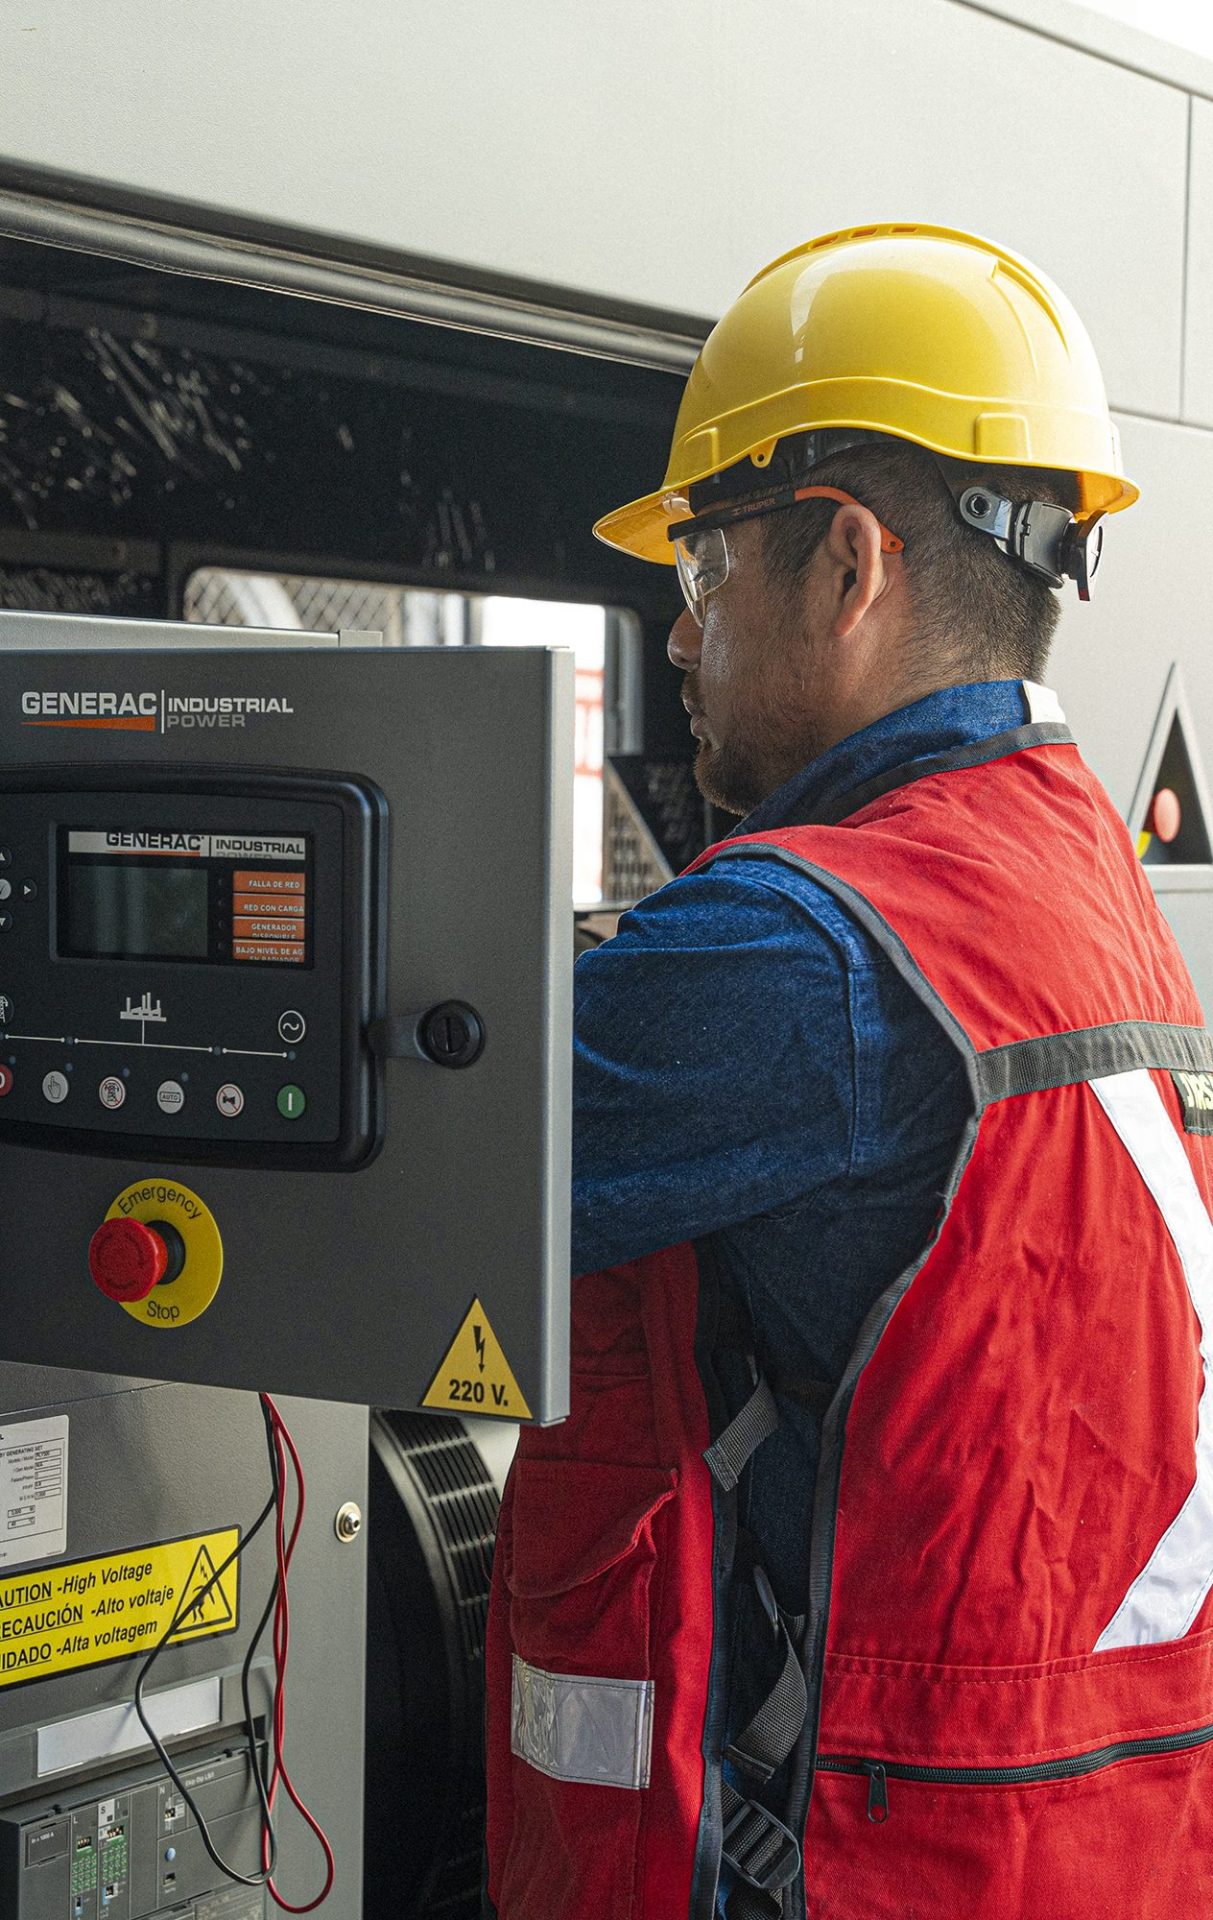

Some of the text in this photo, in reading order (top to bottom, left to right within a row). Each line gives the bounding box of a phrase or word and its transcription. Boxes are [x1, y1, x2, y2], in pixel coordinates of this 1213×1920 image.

[21, 691, 294, 715] GENERAC INDUSTRIAL
[167, 714, 246, 728] POWER
[106, 832, 304, 854] GENERAC INDUSTRIAL
[236, 946, 255, 954] BAJO
[118, 1186, 202, 1220] Emergency
[146, 1300, 180, 1322] Stop
[449, 1379, 508, 1406] 220 V.
[57, 1572, 96, 1595] -High
[101, 1562, 152, 1585] Voltage
[0, 1585, 174, 1638] ECAUCIÓN -Alto voltaje
[56, 1637, 89, 1656] -Alta
[94, 1620, 157, 1646] voltagem
[159, 1787, 165, 1795] N
[73, 1816, 78, 1824] L
[101, 1806, 106, 1814] S
